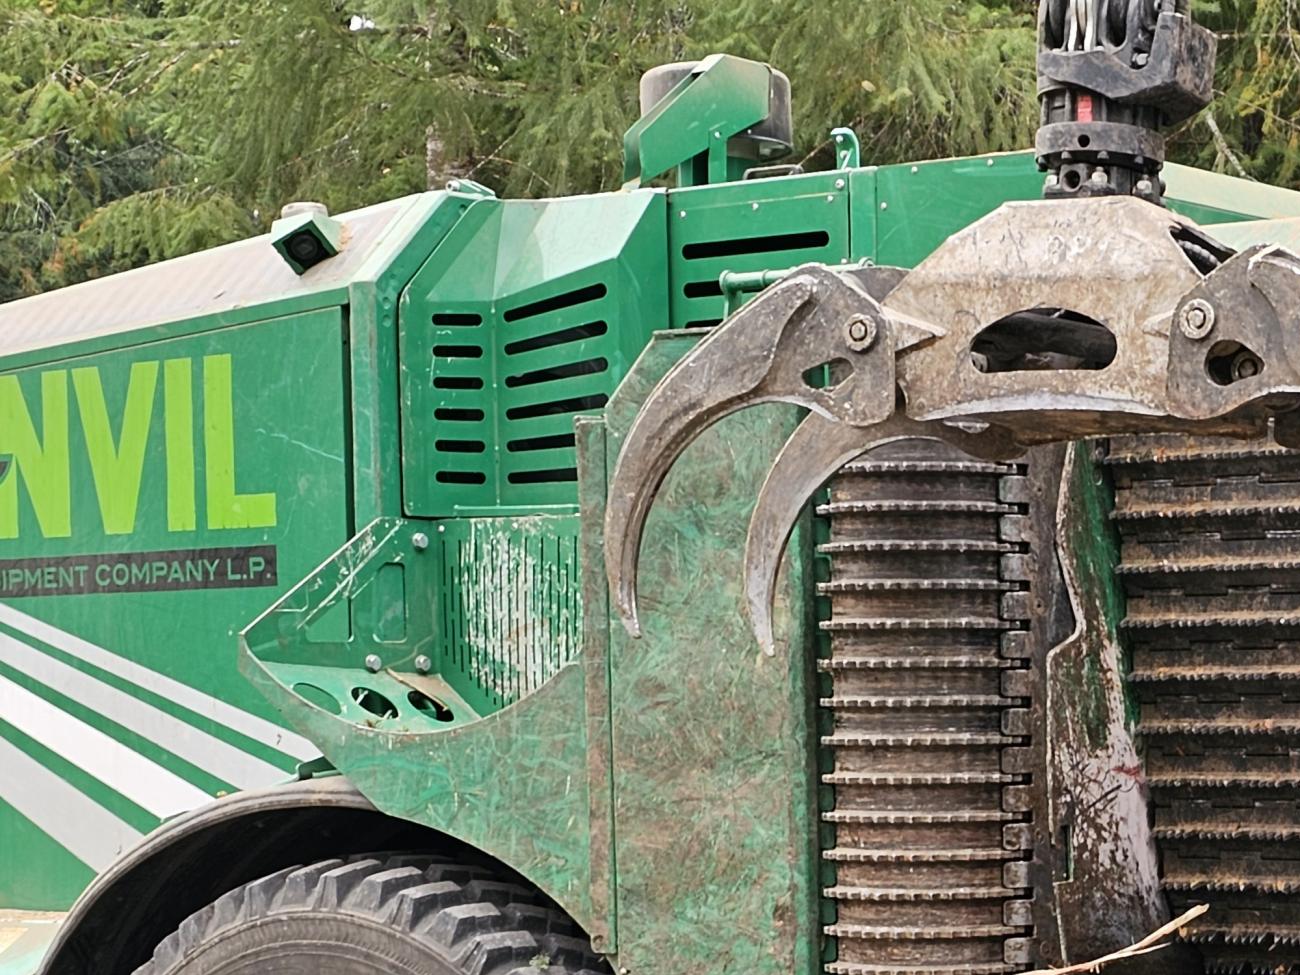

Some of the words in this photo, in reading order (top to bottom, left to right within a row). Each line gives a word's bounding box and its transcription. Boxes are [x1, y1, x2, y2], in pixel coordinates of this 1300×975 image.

[1, 564, 89, 591] IPMENT
[95, 557, 220, 587] COMPANY
[227, 556, 271, 580] L.P.
